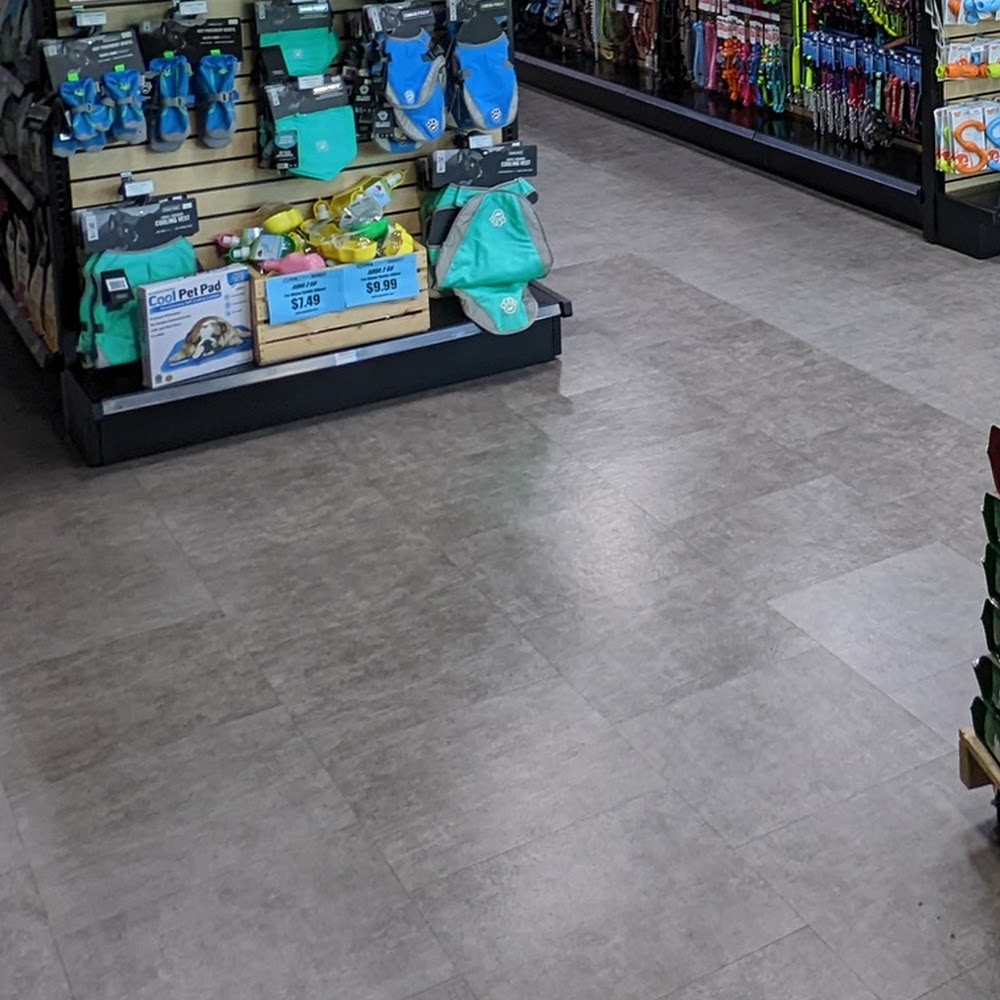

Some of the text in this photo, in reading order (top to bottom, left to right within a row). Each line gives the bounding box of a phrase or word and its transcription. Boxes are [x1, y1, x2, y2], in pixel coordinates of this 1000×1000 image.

[154, 214, 190, 227] COOLING VEST
[148, 290, 177, 308] Cool
[178, 286, 198, 301] Pet
[199, 280, 222, 297] Pad
[366, 278, 398, 294] $9.99
[290, 293, 321, 311] $7.49
